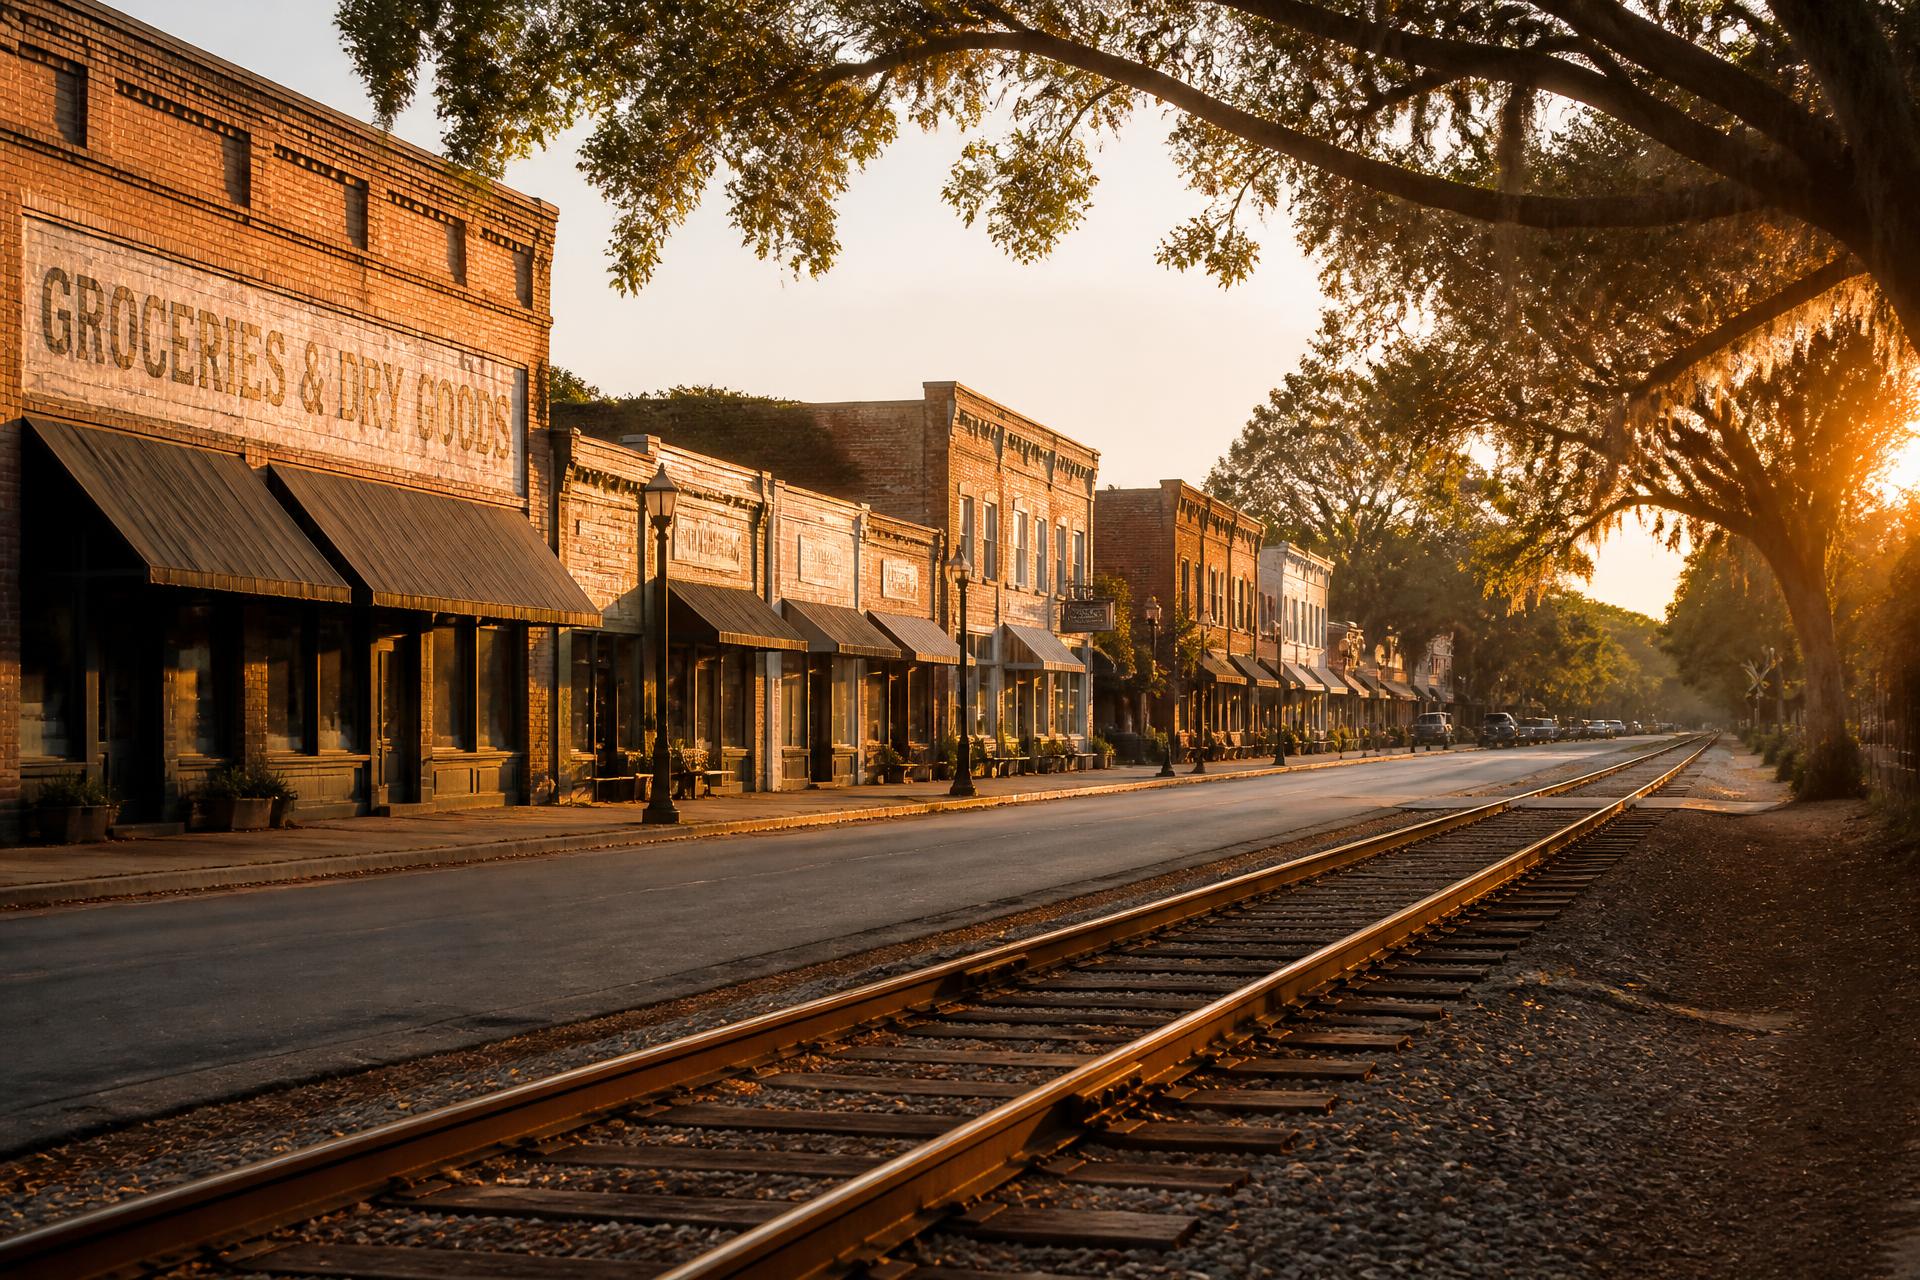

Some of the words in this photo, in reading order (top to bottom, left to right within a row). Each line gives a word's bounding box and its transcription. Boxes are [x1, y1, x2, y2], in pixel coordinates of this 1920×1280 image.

[42, 267, 286, 407] GROCERIES
[302, 340, 325, 416] &
[340, 349, 405, 433] DRY
[417, 373, 510, 460] GOODS
